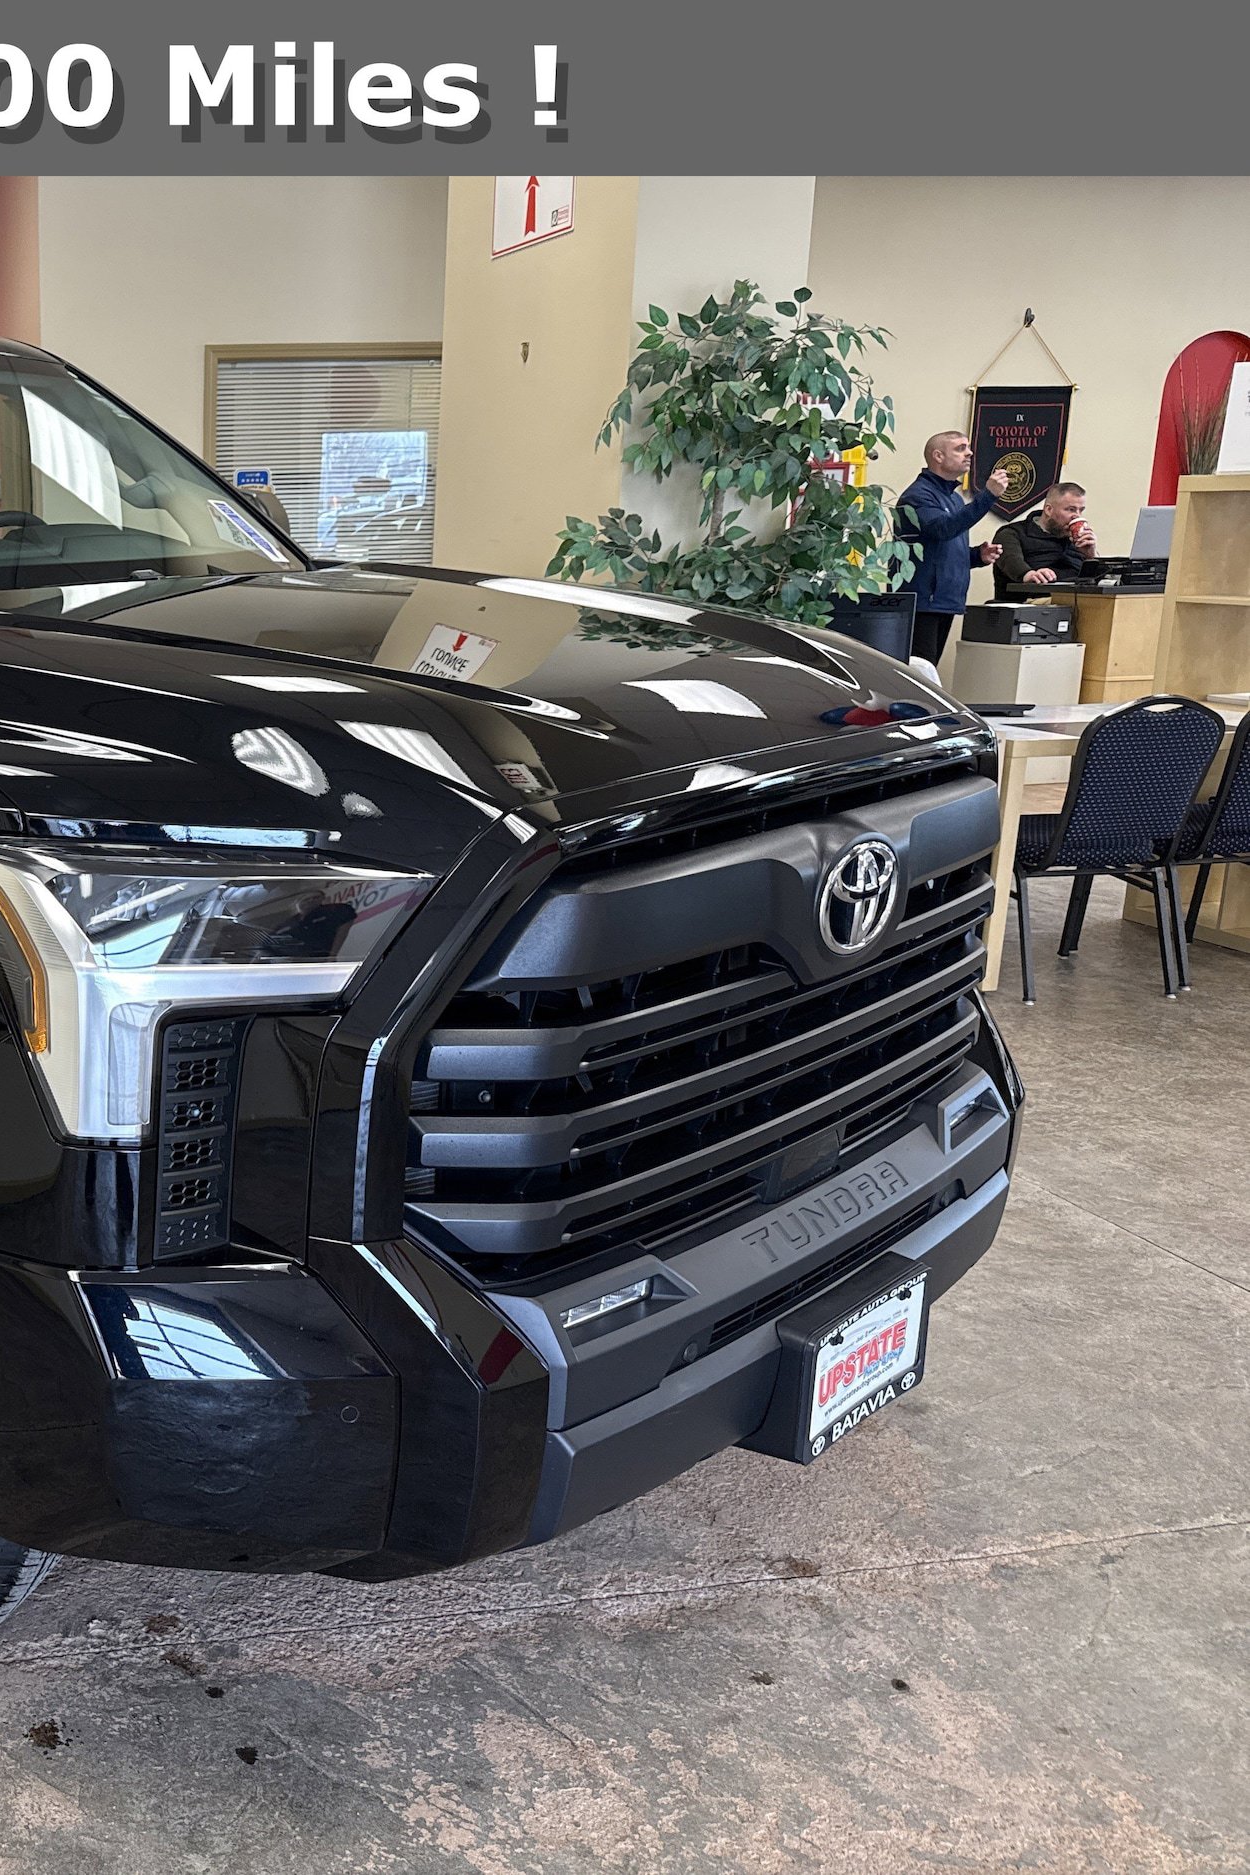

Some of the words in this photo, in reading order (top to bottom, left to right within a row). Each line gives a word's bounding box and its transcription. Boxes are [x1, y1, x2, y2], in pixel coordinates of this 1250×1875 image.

[989, 426, 1030, 437] TOYOTA
[1033, 426, 1048, 436] OF
[995, 437, 1038, 448] BATAVIA
[870, 598, 906, 607] acer
[741, 1160, 909, 1264] TUNDRA
[820, 1312, 860, 1348] UPSTATE
[859, 1295, 888, 1318] AUTO
[890, 1272, 928, 1299] GROUP
[818, 1318, 908, 1407] UPSTATE
[831, 1384, 896, 1443] BATAVIA
